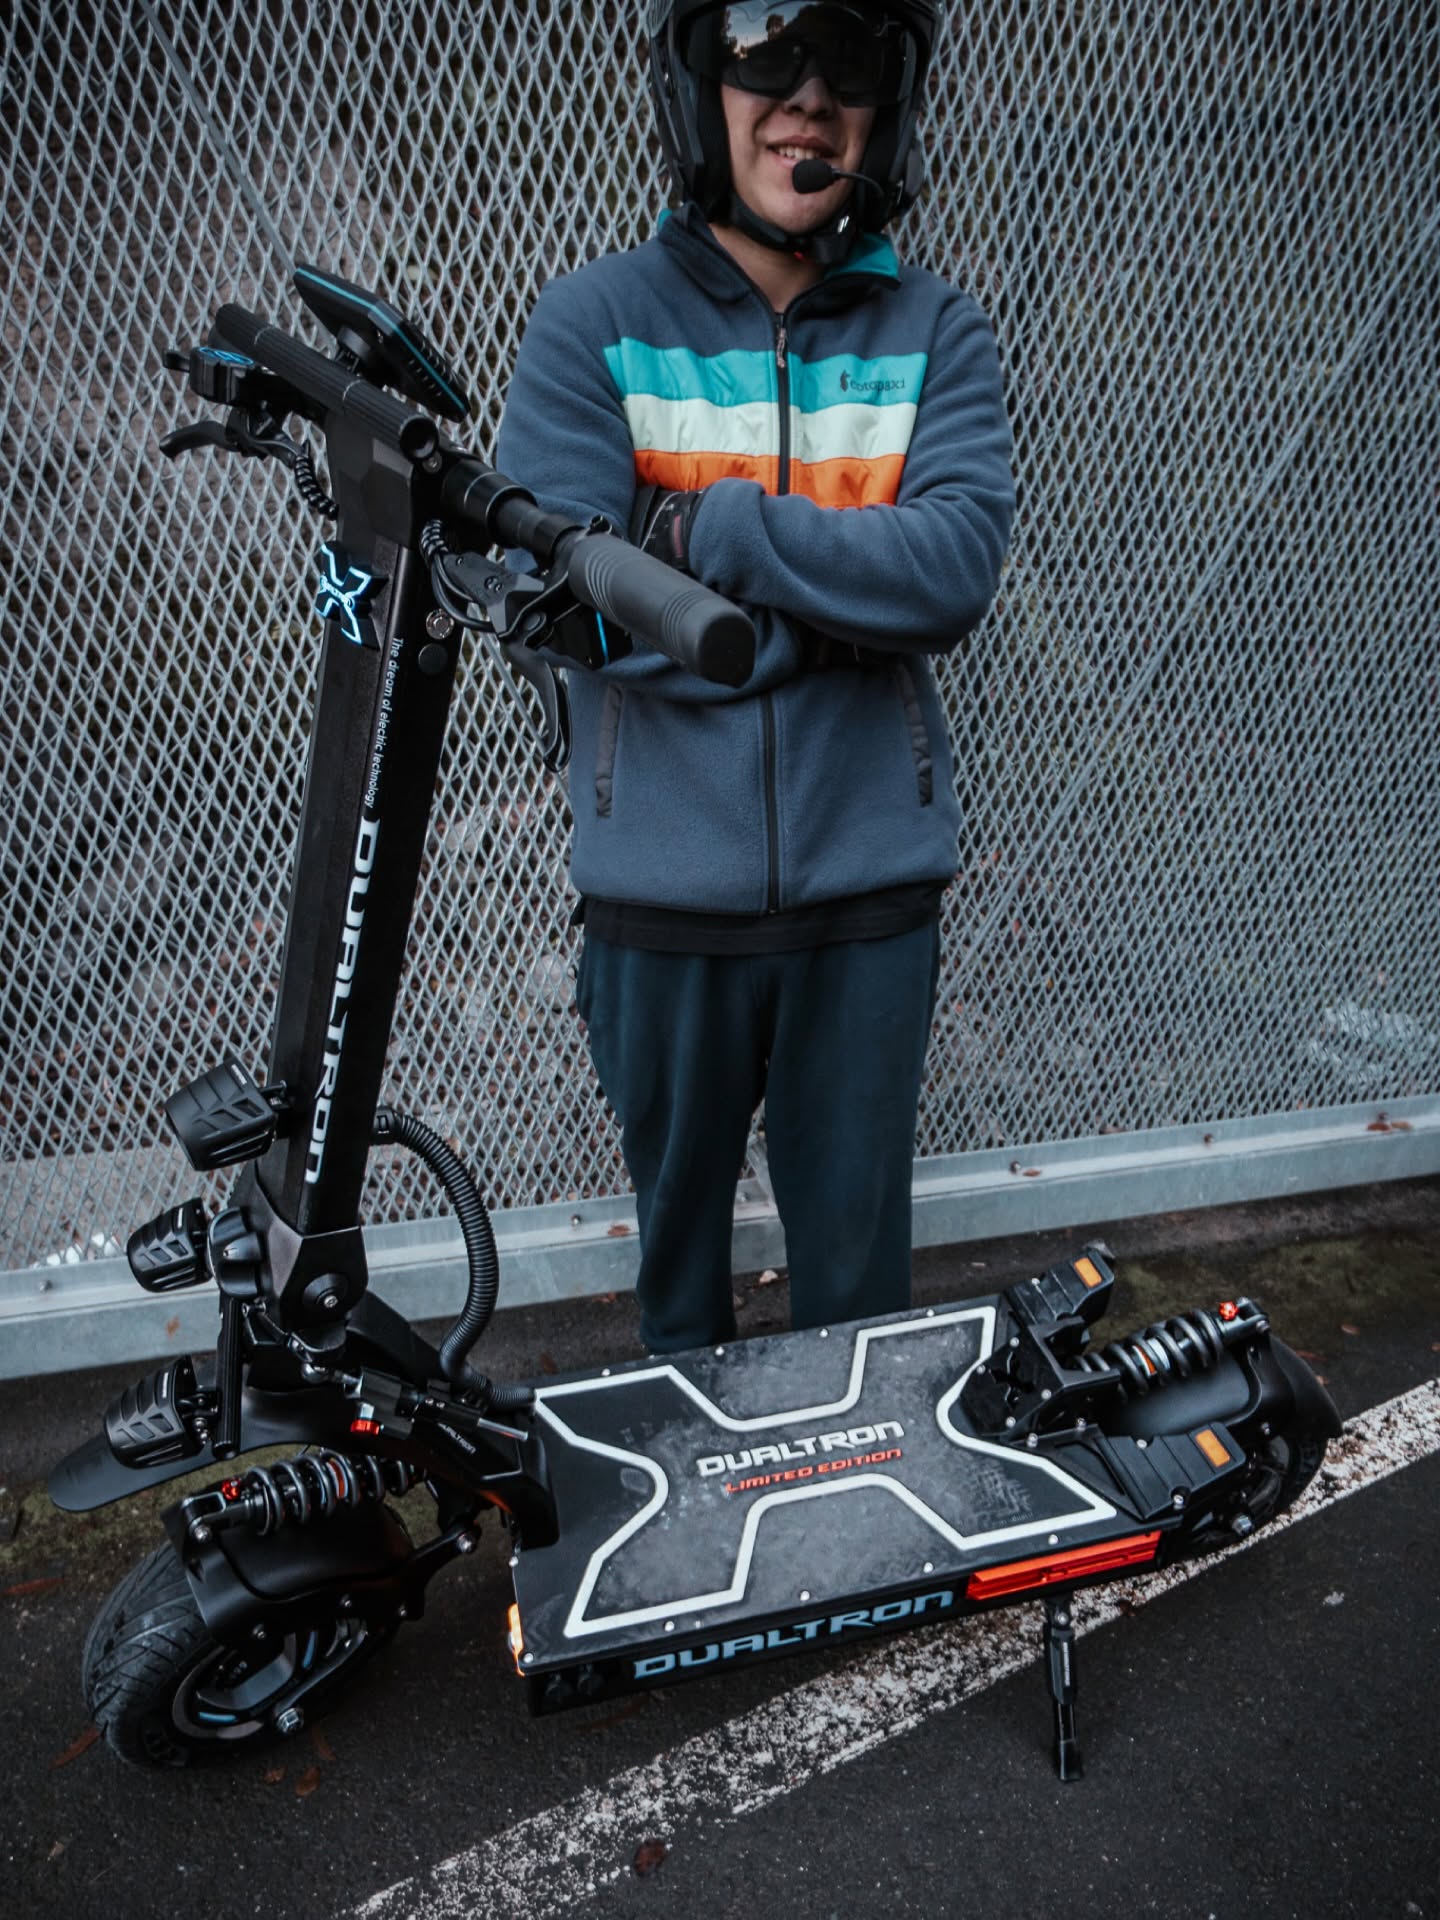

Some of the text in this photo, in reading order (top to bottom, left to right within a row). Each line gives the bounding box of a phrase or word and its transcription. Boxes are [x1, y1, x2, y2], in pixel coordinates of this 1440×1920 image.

[850, 378, 905, 392] cotopaxi
[364, 637, 404, 808] The dream of electric technology
[305, 815, 380, 1184] DUALTRON
[696, 1421, 905, 1477] DUALTRON
[725, 1448, 902, 1493] LIMITED EDITION
[633, 1590, 954, 1679] DUALTRON
